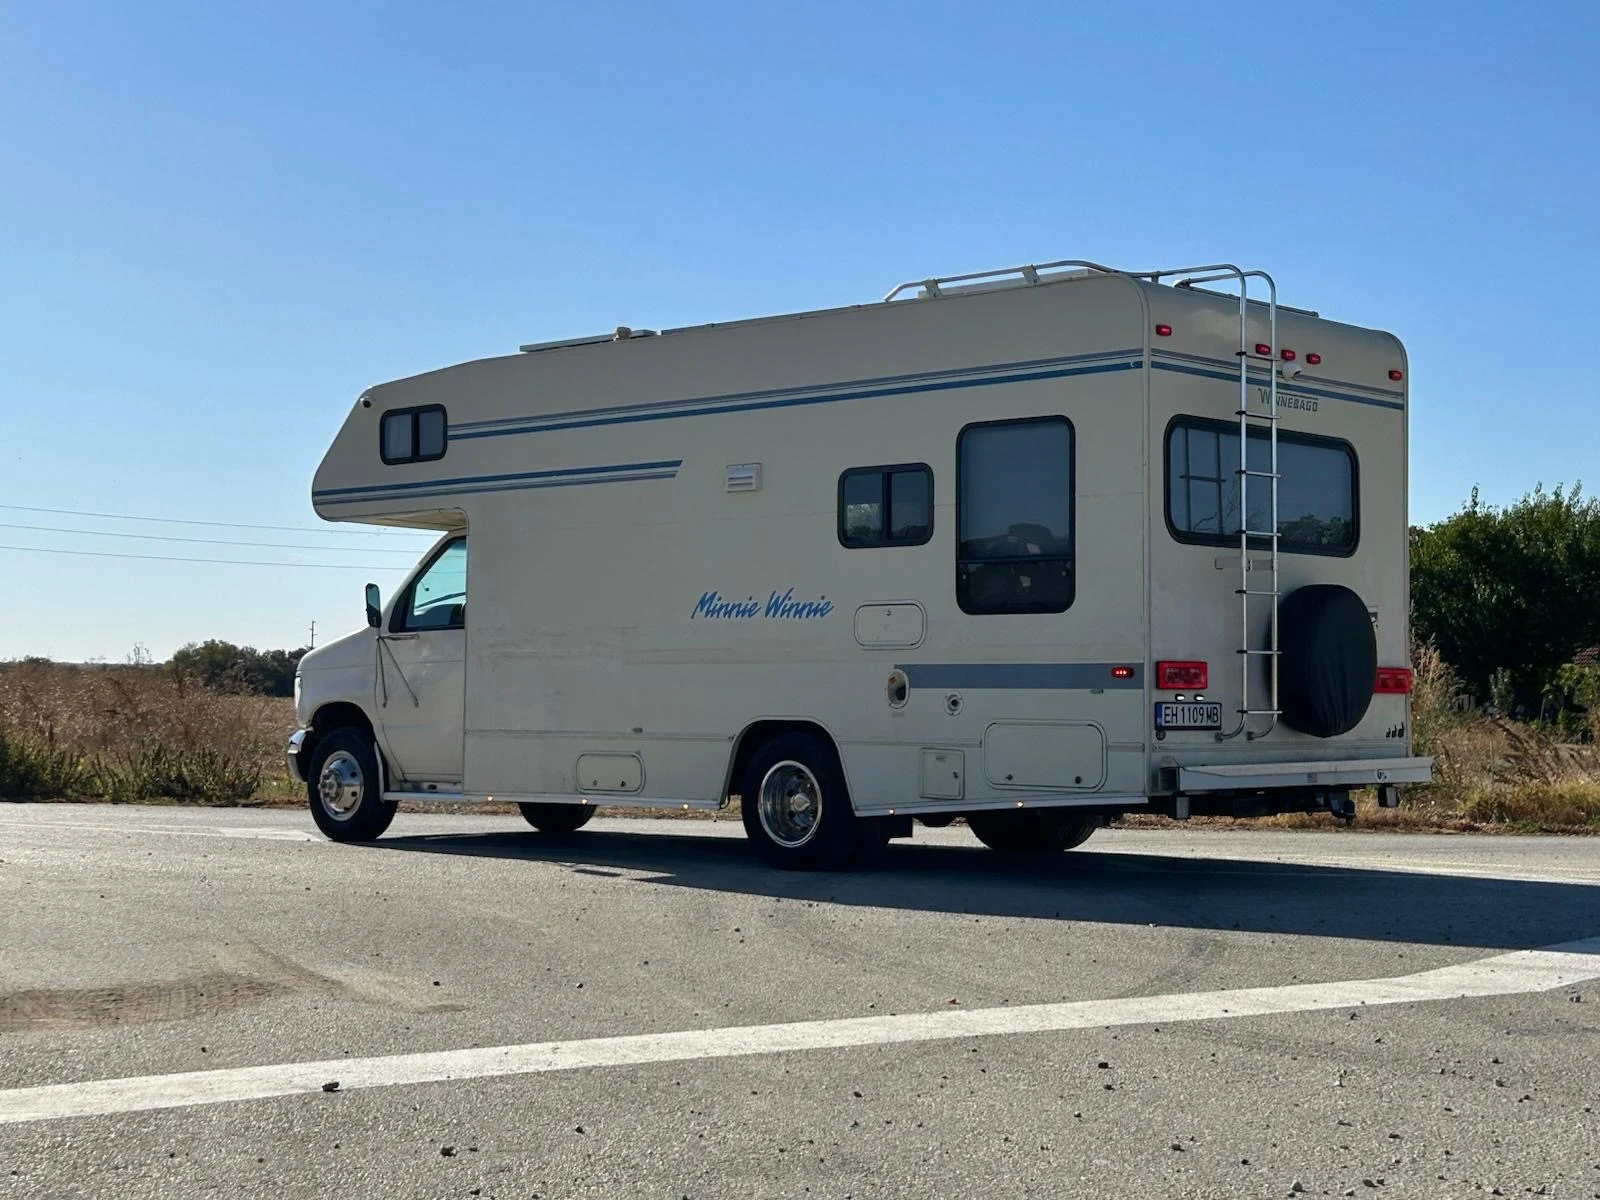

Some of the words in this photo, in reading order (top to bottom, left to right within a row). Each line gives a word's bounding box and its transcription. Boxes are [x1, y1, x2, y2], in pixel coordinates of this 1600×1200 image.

[1257, 387, 1319, 412] WNNEBAGO
[691, 591, 761, 619] Minnie
[765, 587, 835, 618] Winnie
